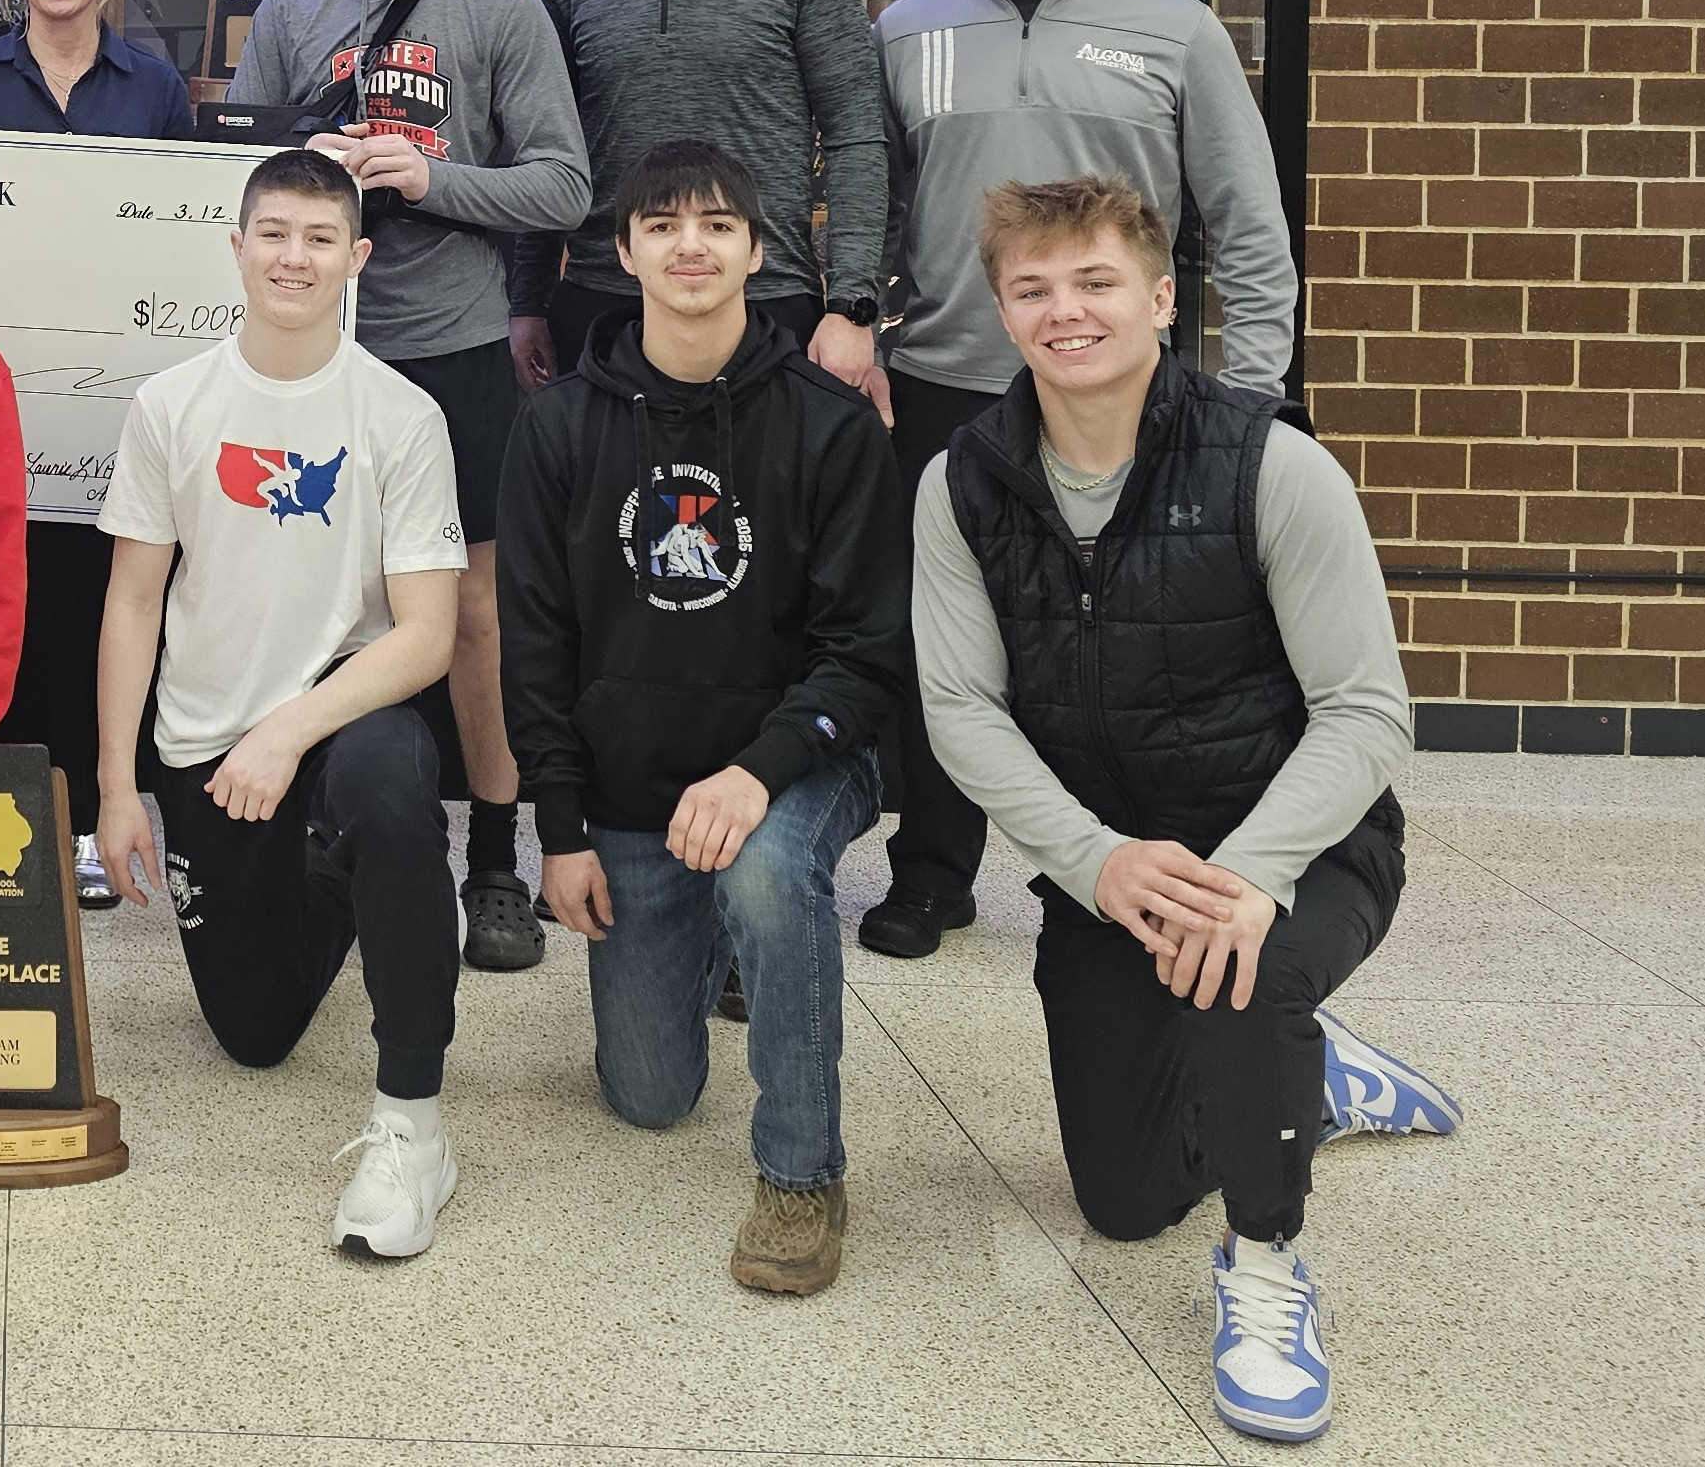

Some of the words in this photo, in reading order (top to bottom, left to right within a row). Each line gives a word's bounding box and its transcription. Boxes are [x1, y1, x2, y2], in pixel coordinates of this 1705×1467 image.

[1075, 42, 1145, 70] ALGONA
[1095, 59, 1145, 75] WRESTLING
[364, 72, 446, 110] MPION
[367, 97, 391, 108] 2025
[381, 107, 407, 118] TEAM
[368, 122, 425, 141] STLING
[115, 201, 155, 220] Date
[133, 298, 150, 329] $
[647, 592, 678, 612] DAKOTA
[682, 587, 728, 611] WISCONSIN
